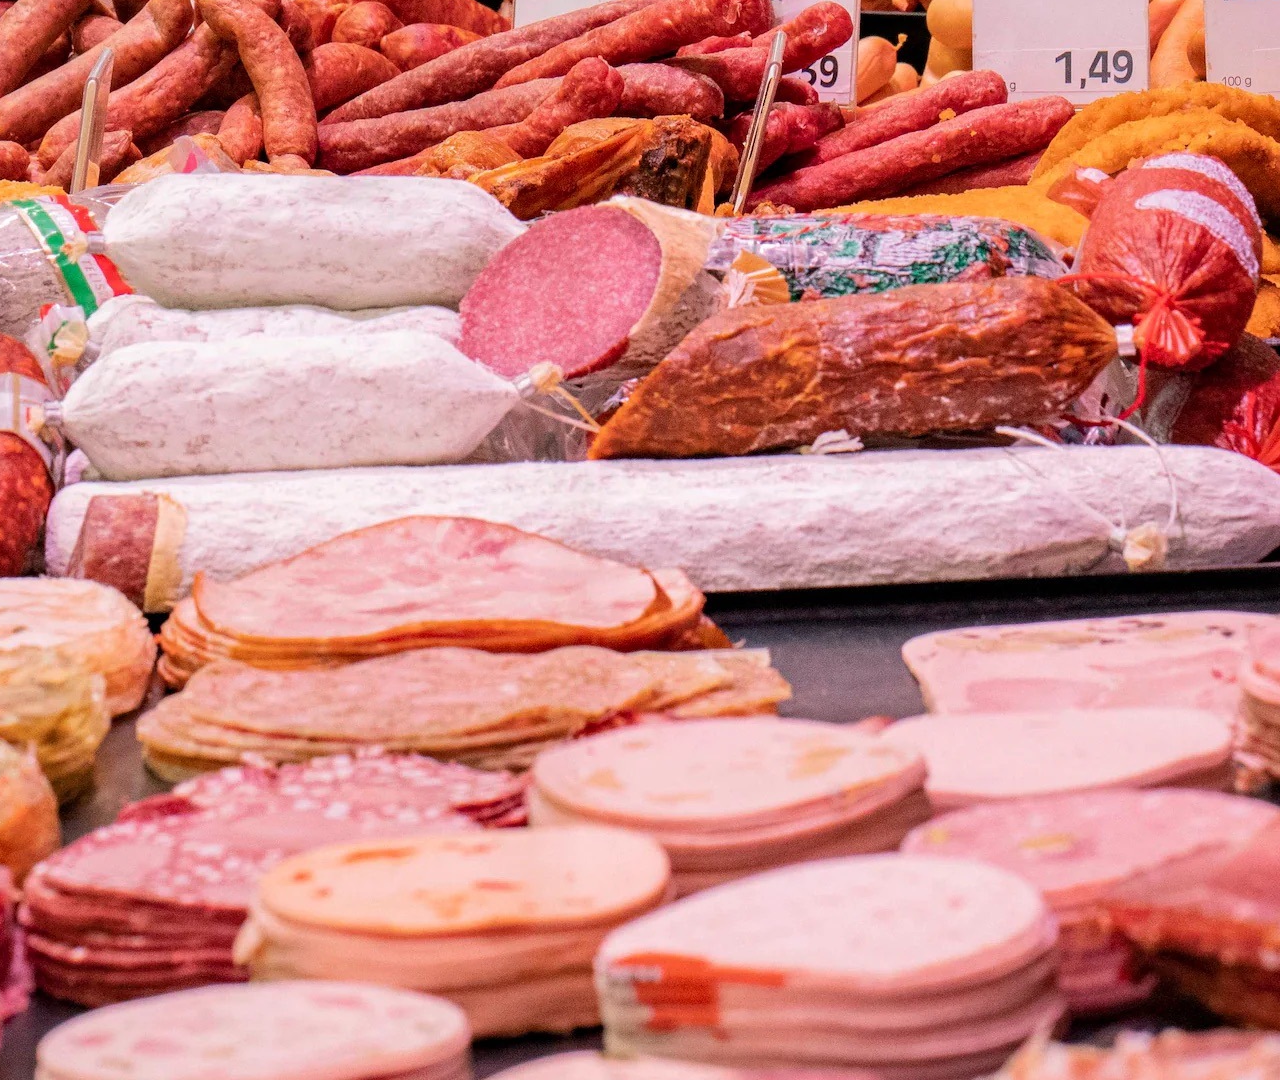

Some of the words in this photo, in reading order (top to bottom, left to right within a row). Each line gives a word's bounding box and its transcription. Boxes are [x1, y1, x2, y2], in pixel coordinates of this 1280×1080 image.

[1055, 50, 1134, 89] 1,49
[1222, 76, 1242, 87] 100
[1245, 77, 1252, 87] g
